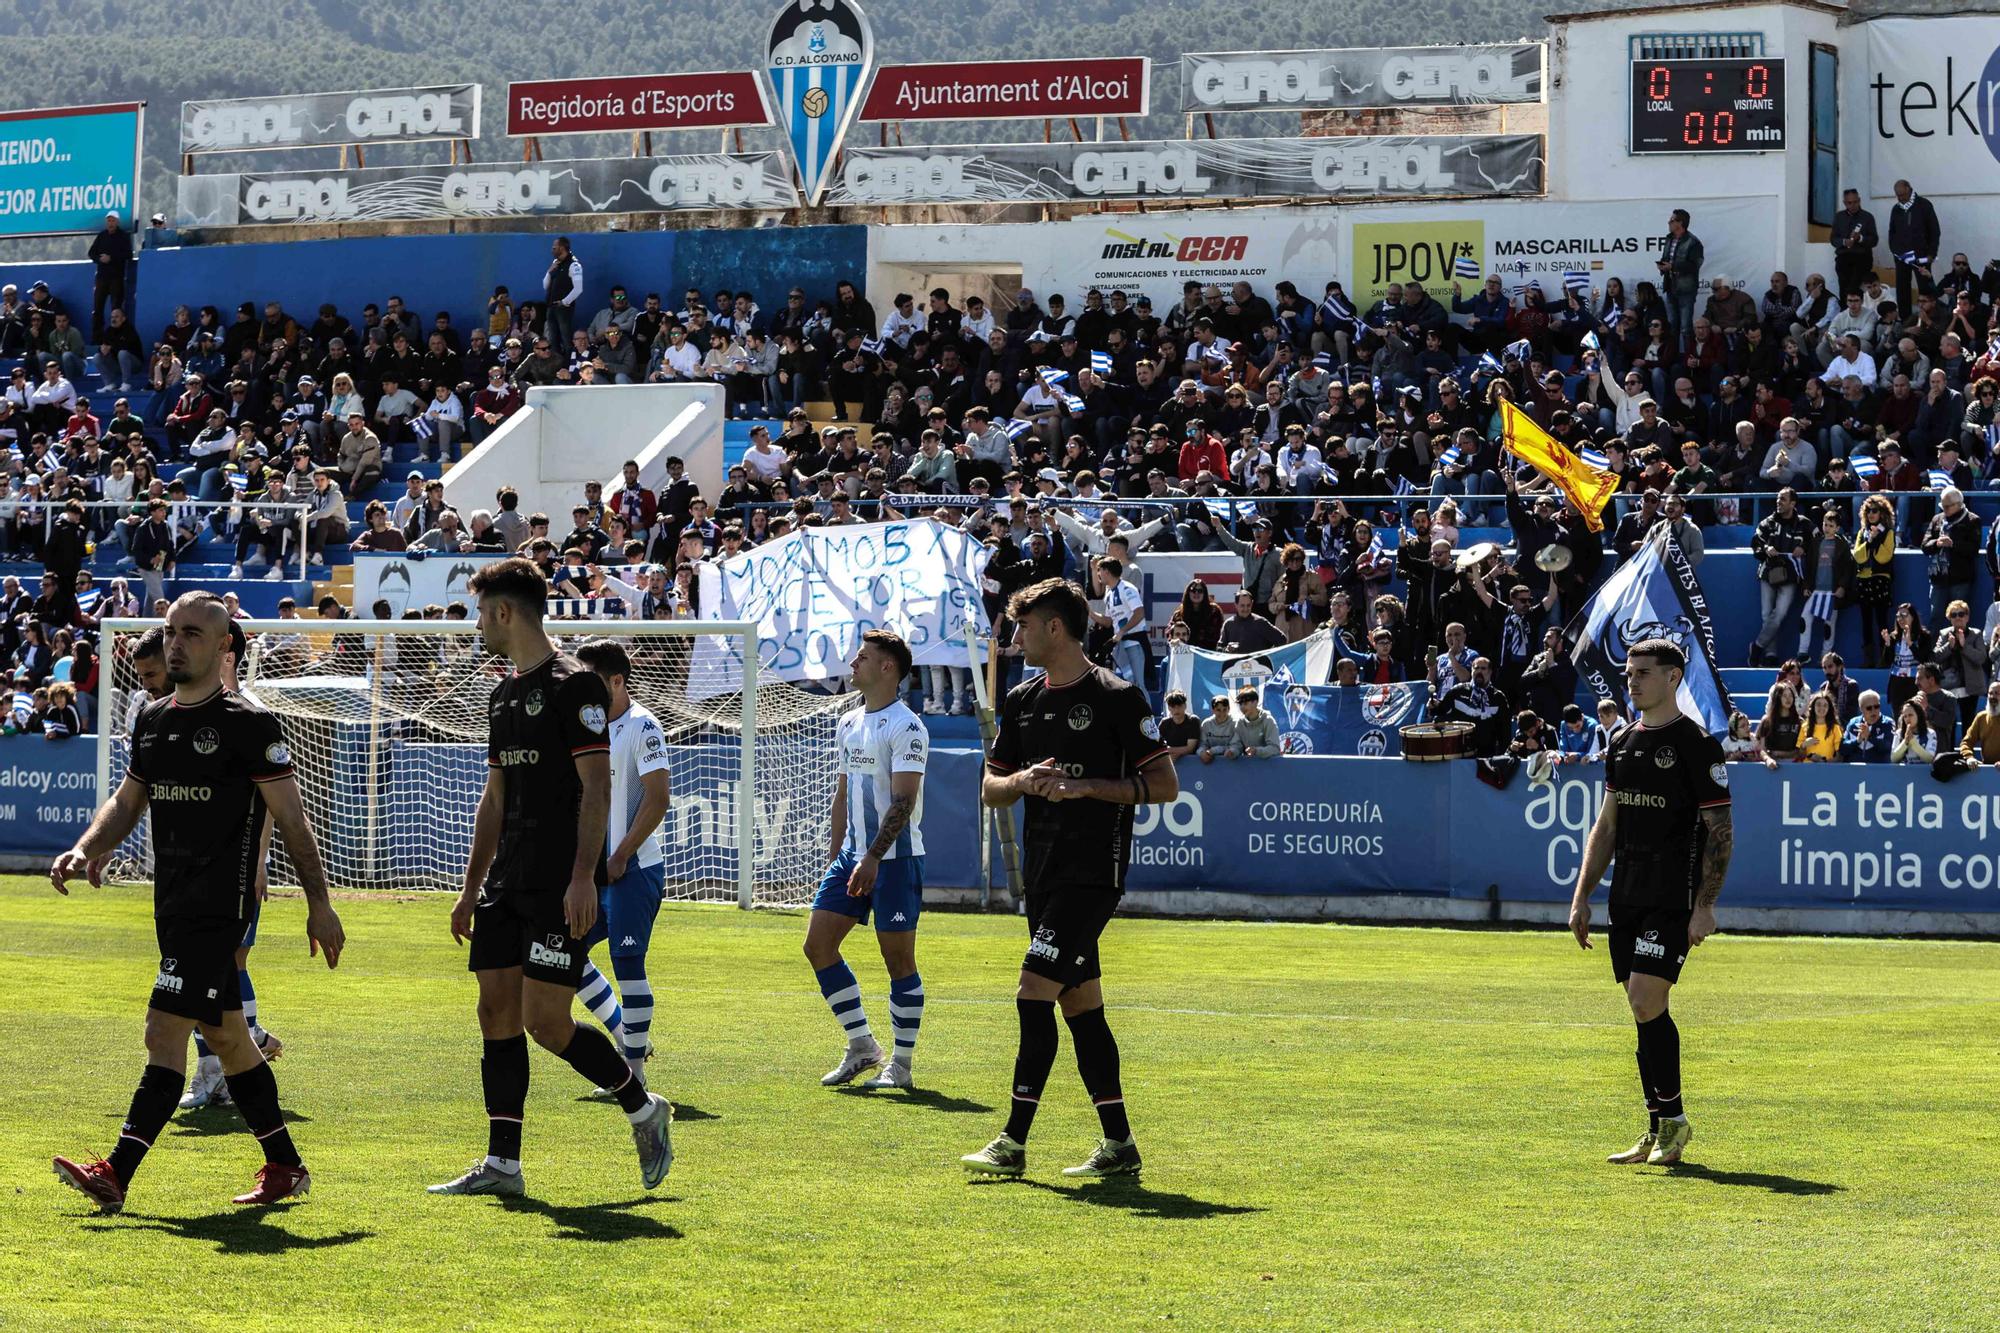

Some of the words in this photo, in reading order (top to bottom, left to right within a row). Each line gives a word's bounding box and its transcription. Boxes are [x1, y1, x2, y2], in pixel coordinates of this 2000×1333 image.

[775, 56, 796, 66] C.D.
[799, 53, 859, 65] ALCOYANO
[1381, 54, 1528, 100] CEROL
[896, 79, 1040, 111] Ajuntament
[1047, 75, 1130, 102] d'Alcoi
[1193, 59, 1335, 105] CEROL
[1649, 66, 1671, 100] 0
[1747, 65, 1769, 98] 0
[346, 94, 462, 138] CEROL
[519, 92, 626, 125] Regidoría
[631, 88, 735, 119] d'Esports
[1647, 101, 1674, 112] LOCAL
[1733, 99, 1774, 110] VISITANTE
[192, 104, 302, 144] CEROL
[1746, 126, 1782, 141] min
[0, 137, 72, 166] IENDO...
[1311, 144, 1455, 191] CEROL
[441, 169, 561, 211] CEROL
[648, 161, 777, 206] CEROL
[844, 154, 977, 198] CEROL
[1072, 150, 1212, 195] CEROL
[39, 175, 127, 213] ATENCIÓN
[246, 177, 360, 221] CEROL
[1495, 237, 1638, 255] MASCARILLAS
[1094, 271, 1168, 279] COMUNICACIONES
[1179, 269, 1238, 277] ELECTRICIDAD
[1240, 268, 1267, 276] ALCOY
[1535, 261, 1547, 272] IN
[1550, 260, 1586, 272] SPAIN
[854, 568, 934, 611] POR
[1587, 669, 1613, 701] 1992
[36, 805, 73, 823] 100.8
[1249, 800, 1384, 824] CORREDURÍA
[1782, 780, 1838, 827] La
[1853, 780, 1944, 829] tela
[1248, 833, 1276, 854] DE
[1283, 834, 1384, 856] SEGUROS
[1780, 838, 1923, 898] limpia
[529, 941, 571, 966] Dom
[157, 973, 184, 990] om
